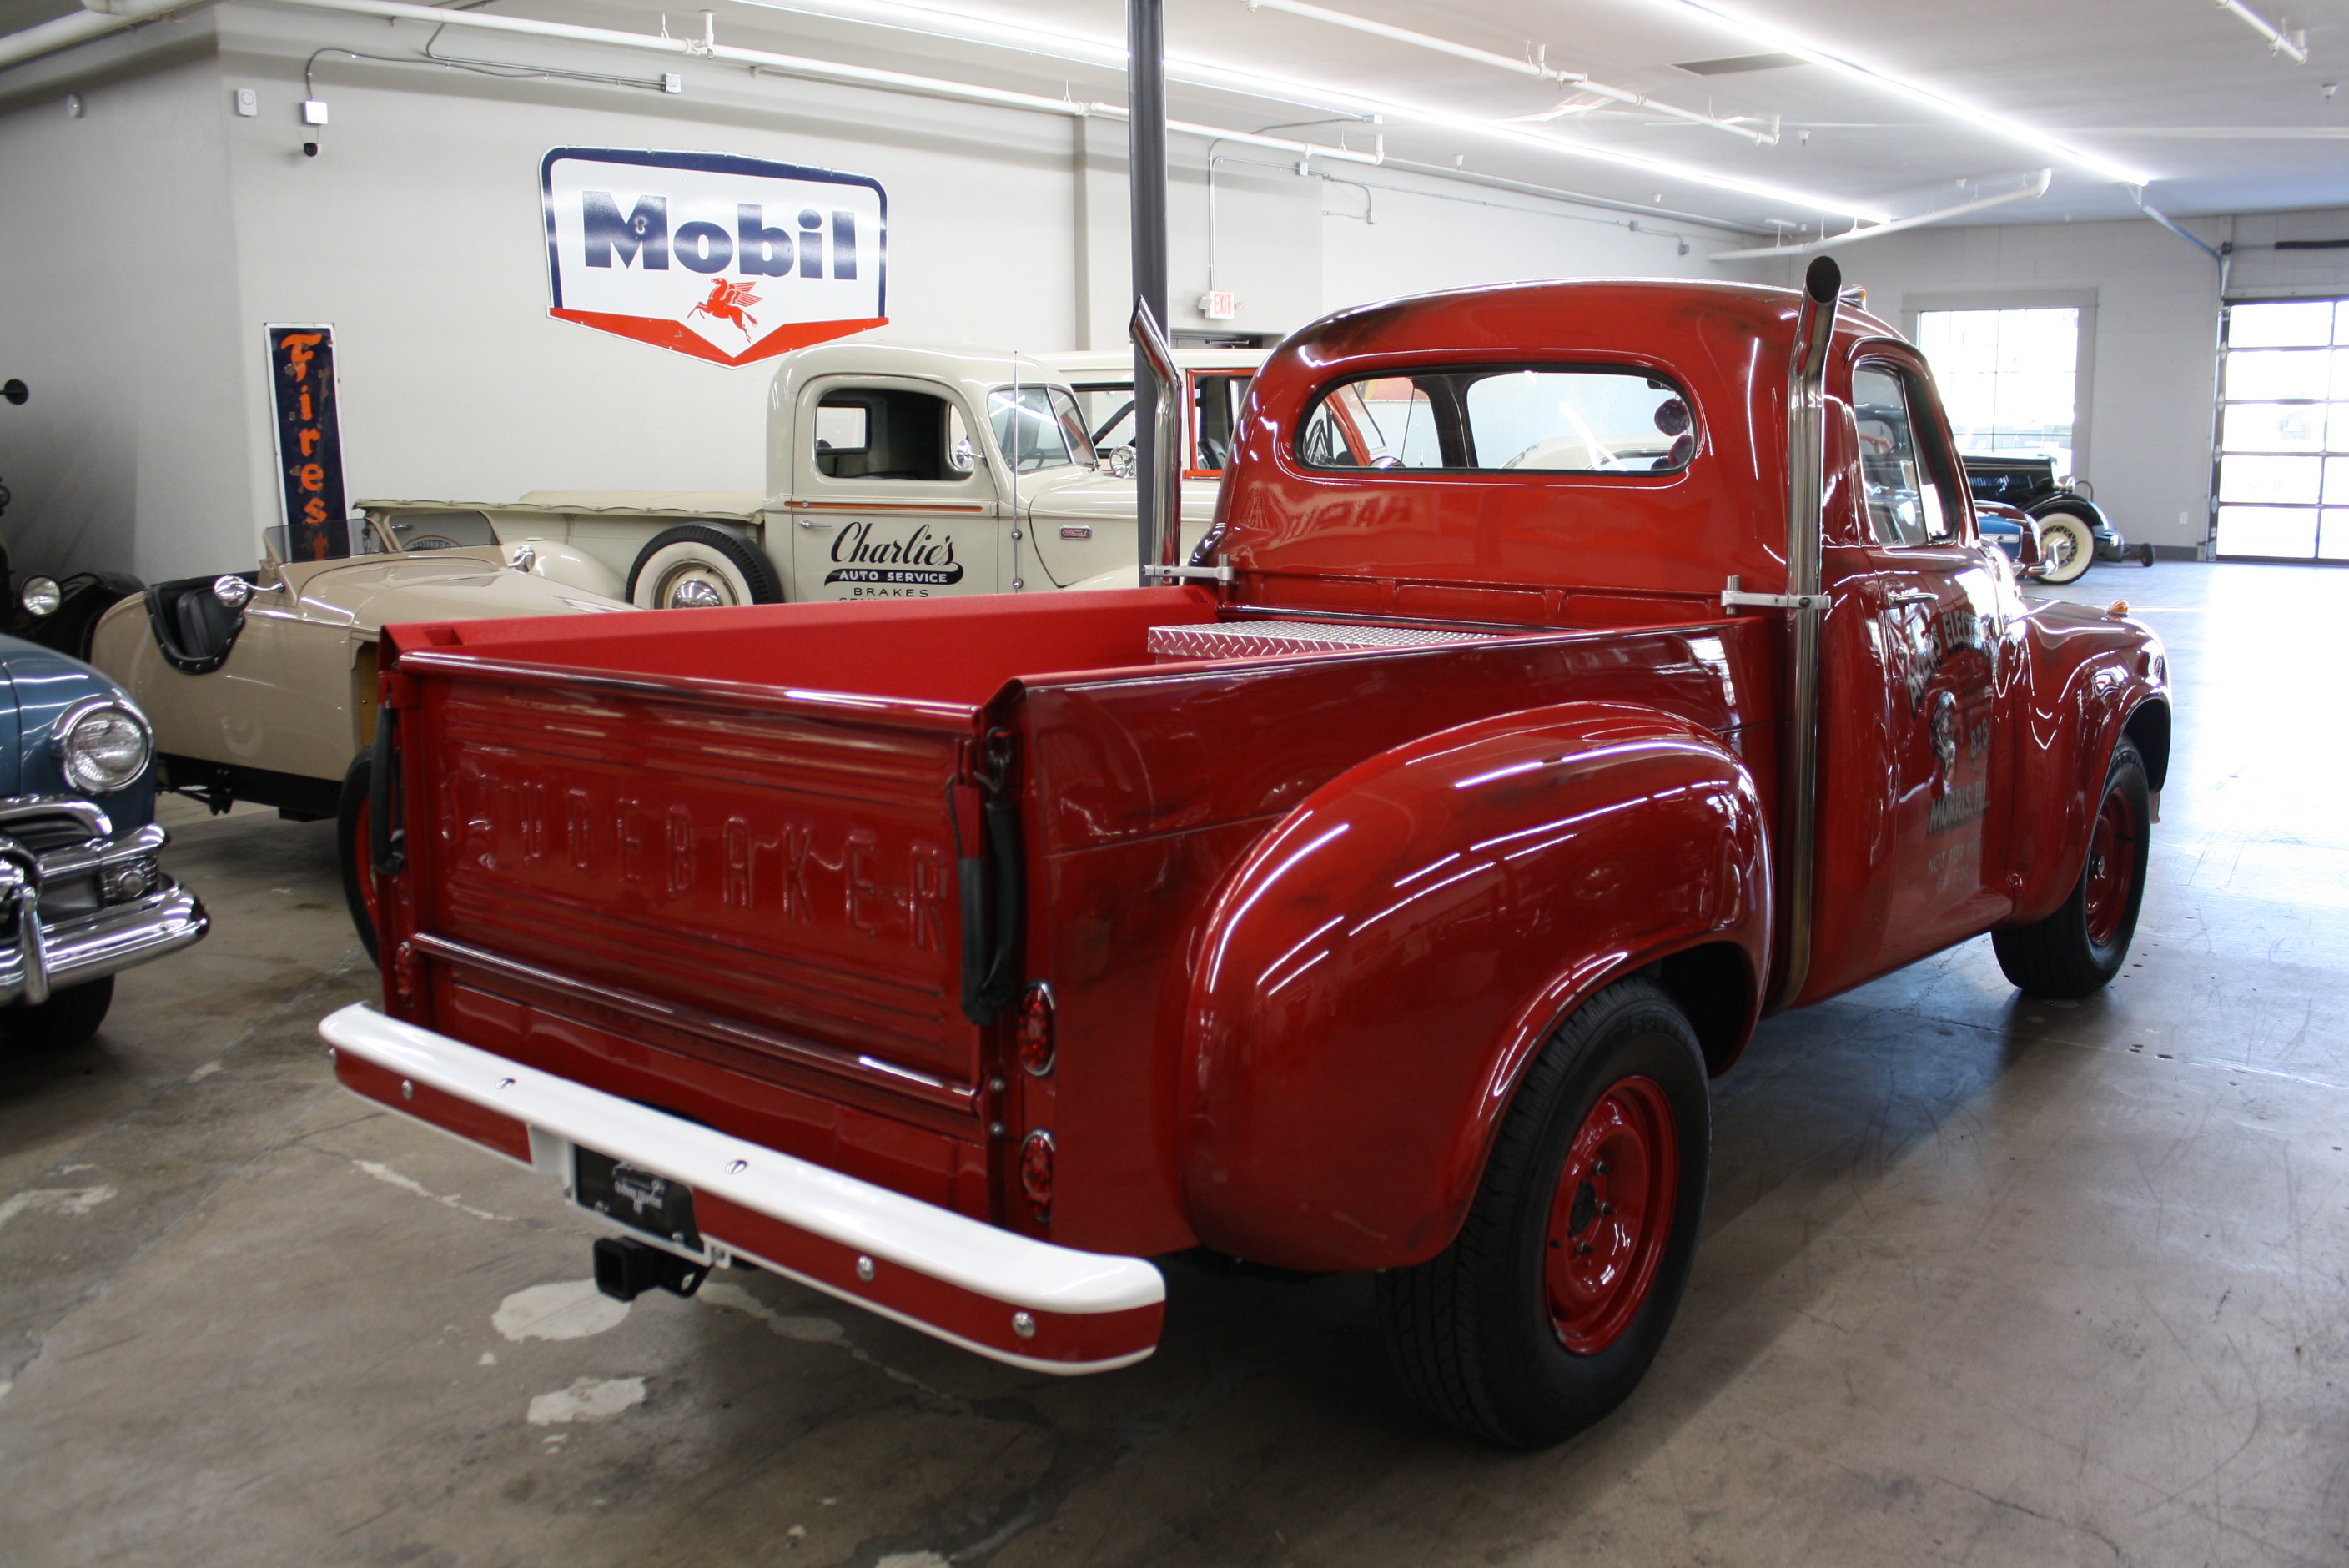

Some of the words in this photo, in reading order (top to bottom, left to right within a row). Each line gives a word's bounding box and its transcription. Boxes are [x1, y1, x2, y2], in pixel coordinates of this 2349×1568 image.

[582, 190, 858, 280] Mobil
[1214, 293, 1231, 314] EXIT
[831, 521, 954, 566] Charlie's
[838, 570, 878, 581] AUTO
[887, 571, 948, 583] SERVICE
[853, 587, 929, 598] BRAKES
